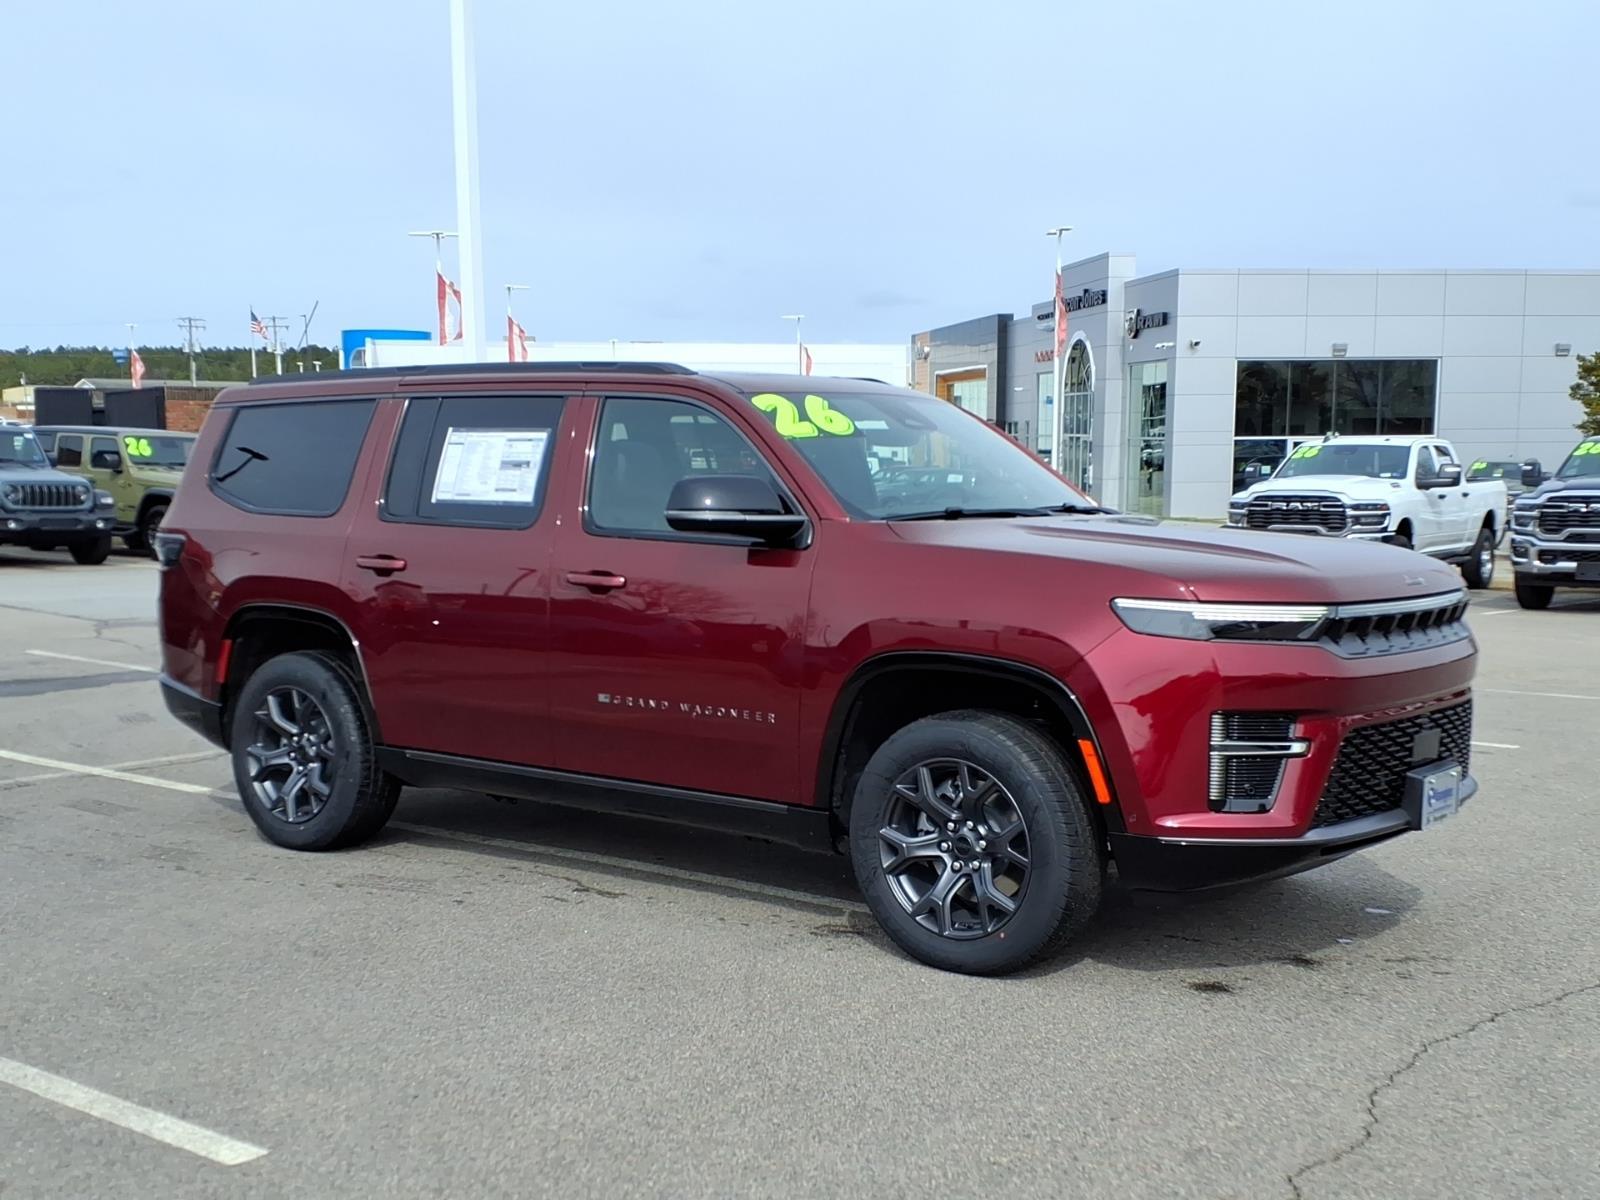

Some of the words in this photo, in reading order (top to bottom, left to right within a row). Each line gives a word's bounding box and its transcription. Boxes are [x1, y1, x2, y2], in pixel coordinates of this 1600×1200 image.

[1137, 312, 1166, 330] RAM
[751, 393, 855, 438] 26
[124, 436, 153, 457] 26
[1291, 446, 1323, 459] 26
[1271, 501, 1321, 511] RAM
[613, 695, 669, 711] GRAND
[679, 702, 777, 724] WAGONEER
